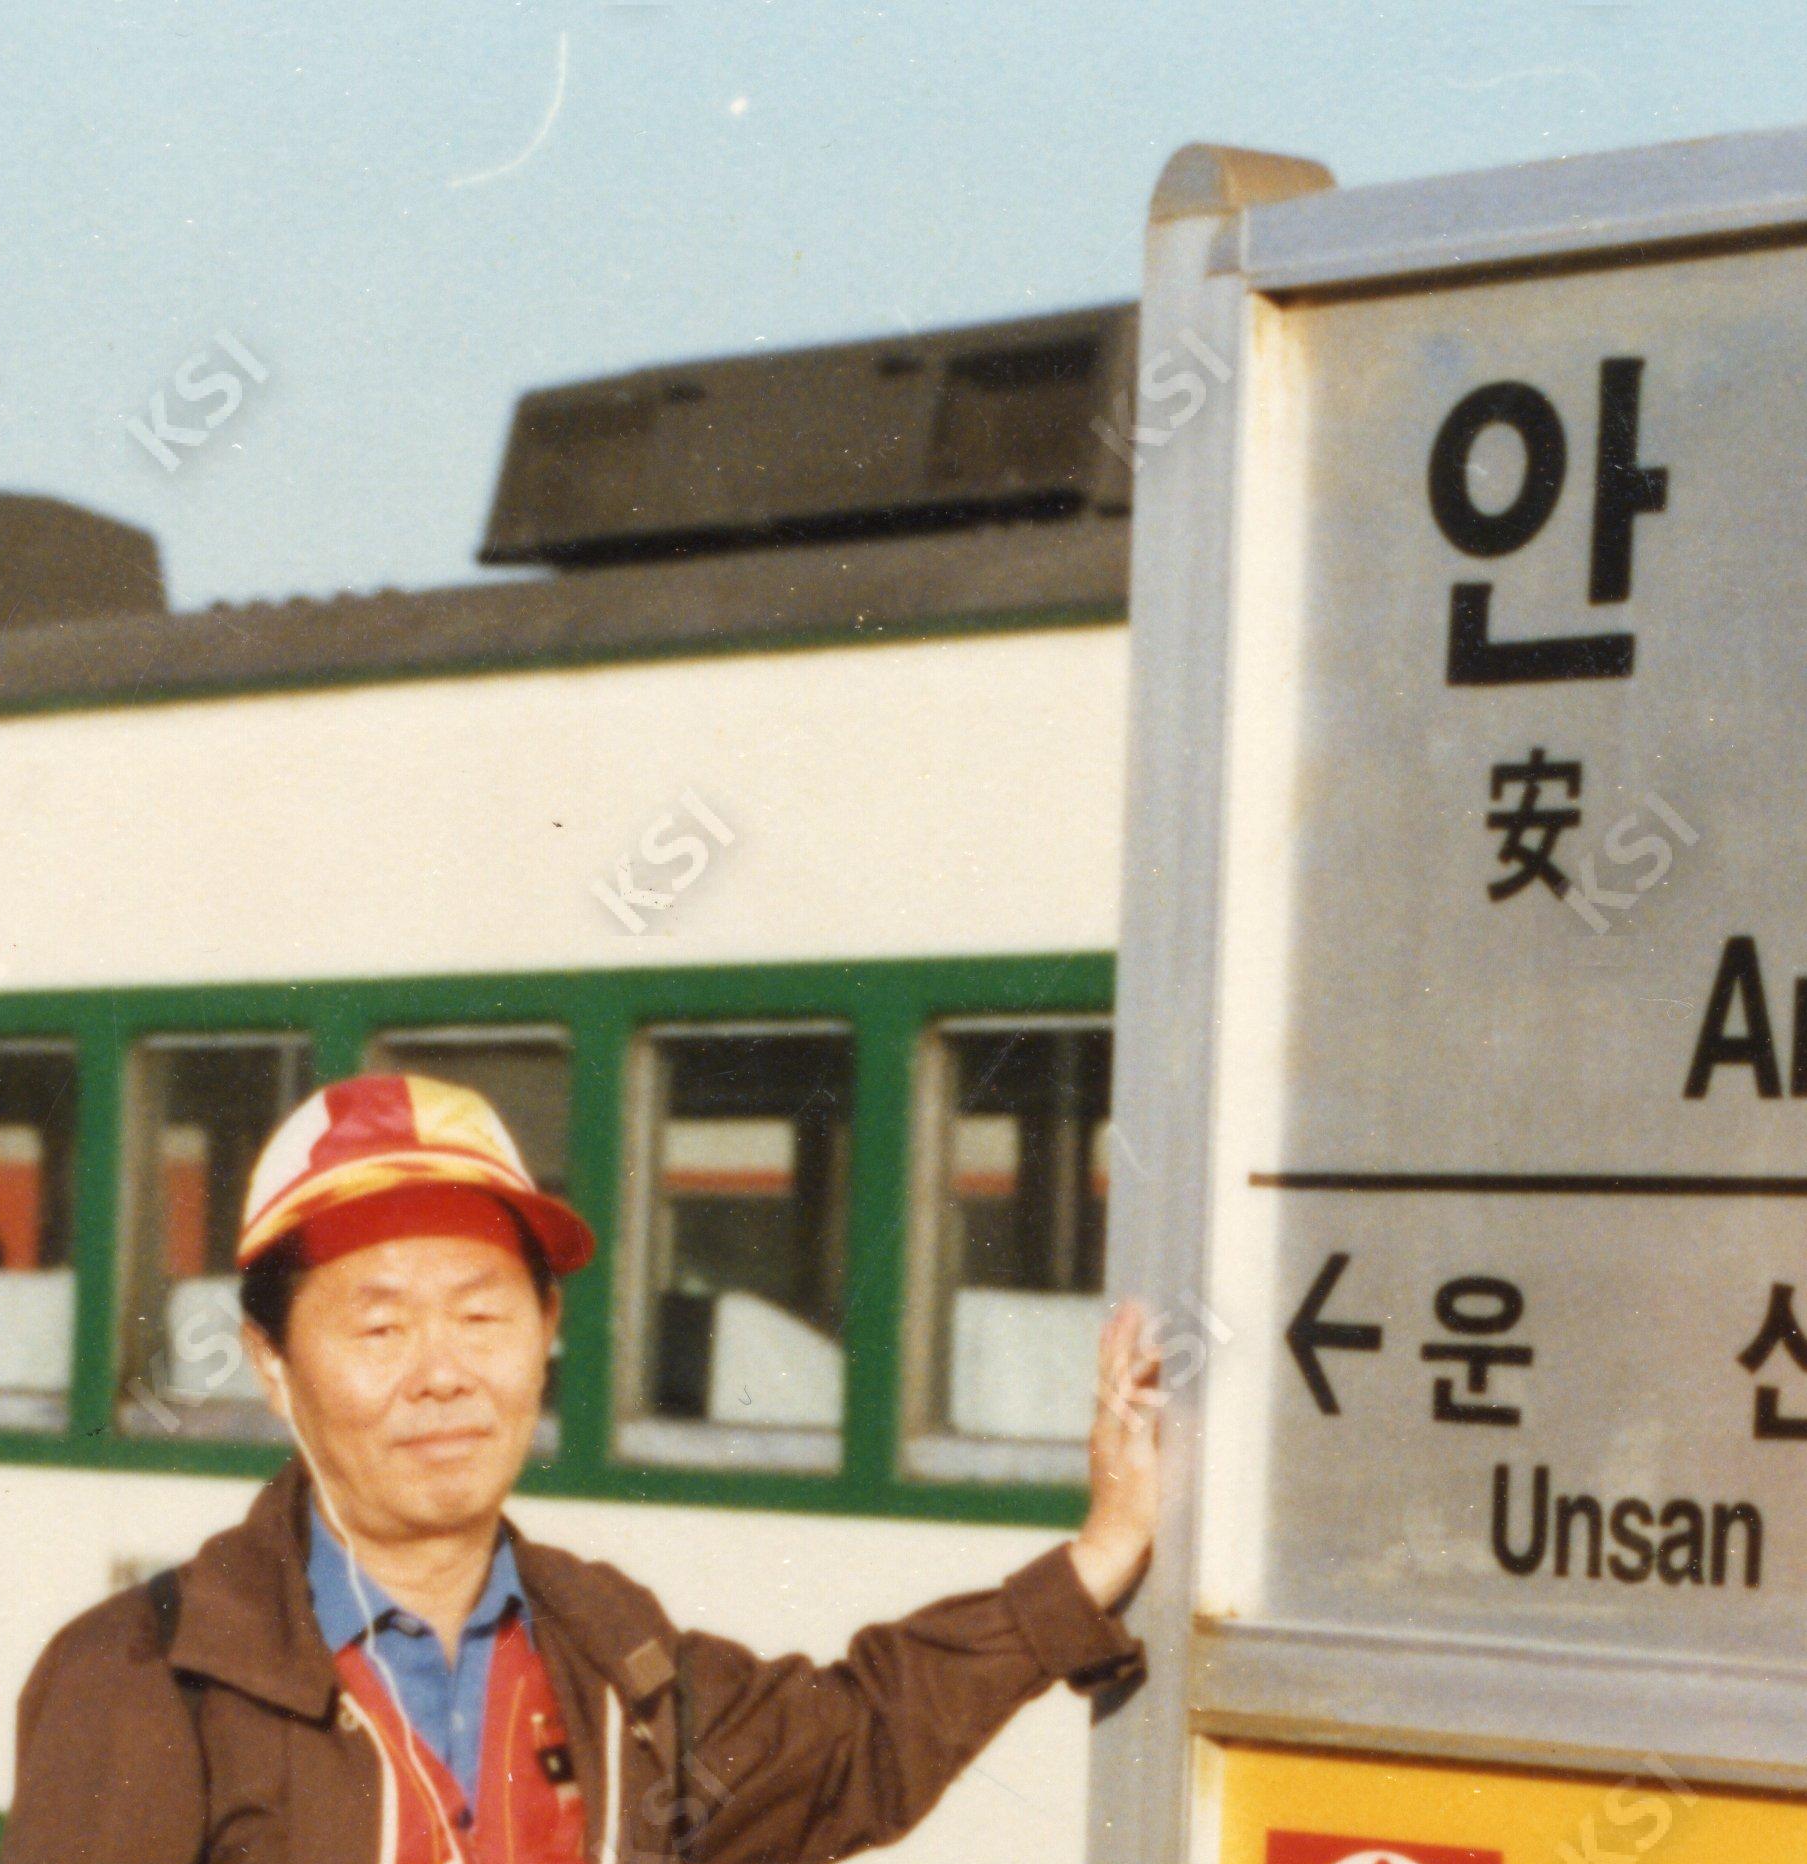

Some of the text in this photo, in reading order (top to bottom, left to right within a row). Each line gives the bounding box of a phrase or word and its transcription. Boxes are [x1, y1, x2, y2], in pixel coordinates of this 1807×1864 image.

[1428, 354, 1669, 688] 안
[1486, 746, 1583, 904] 安
[1491, 1462, 1763, 1589] Unsan
